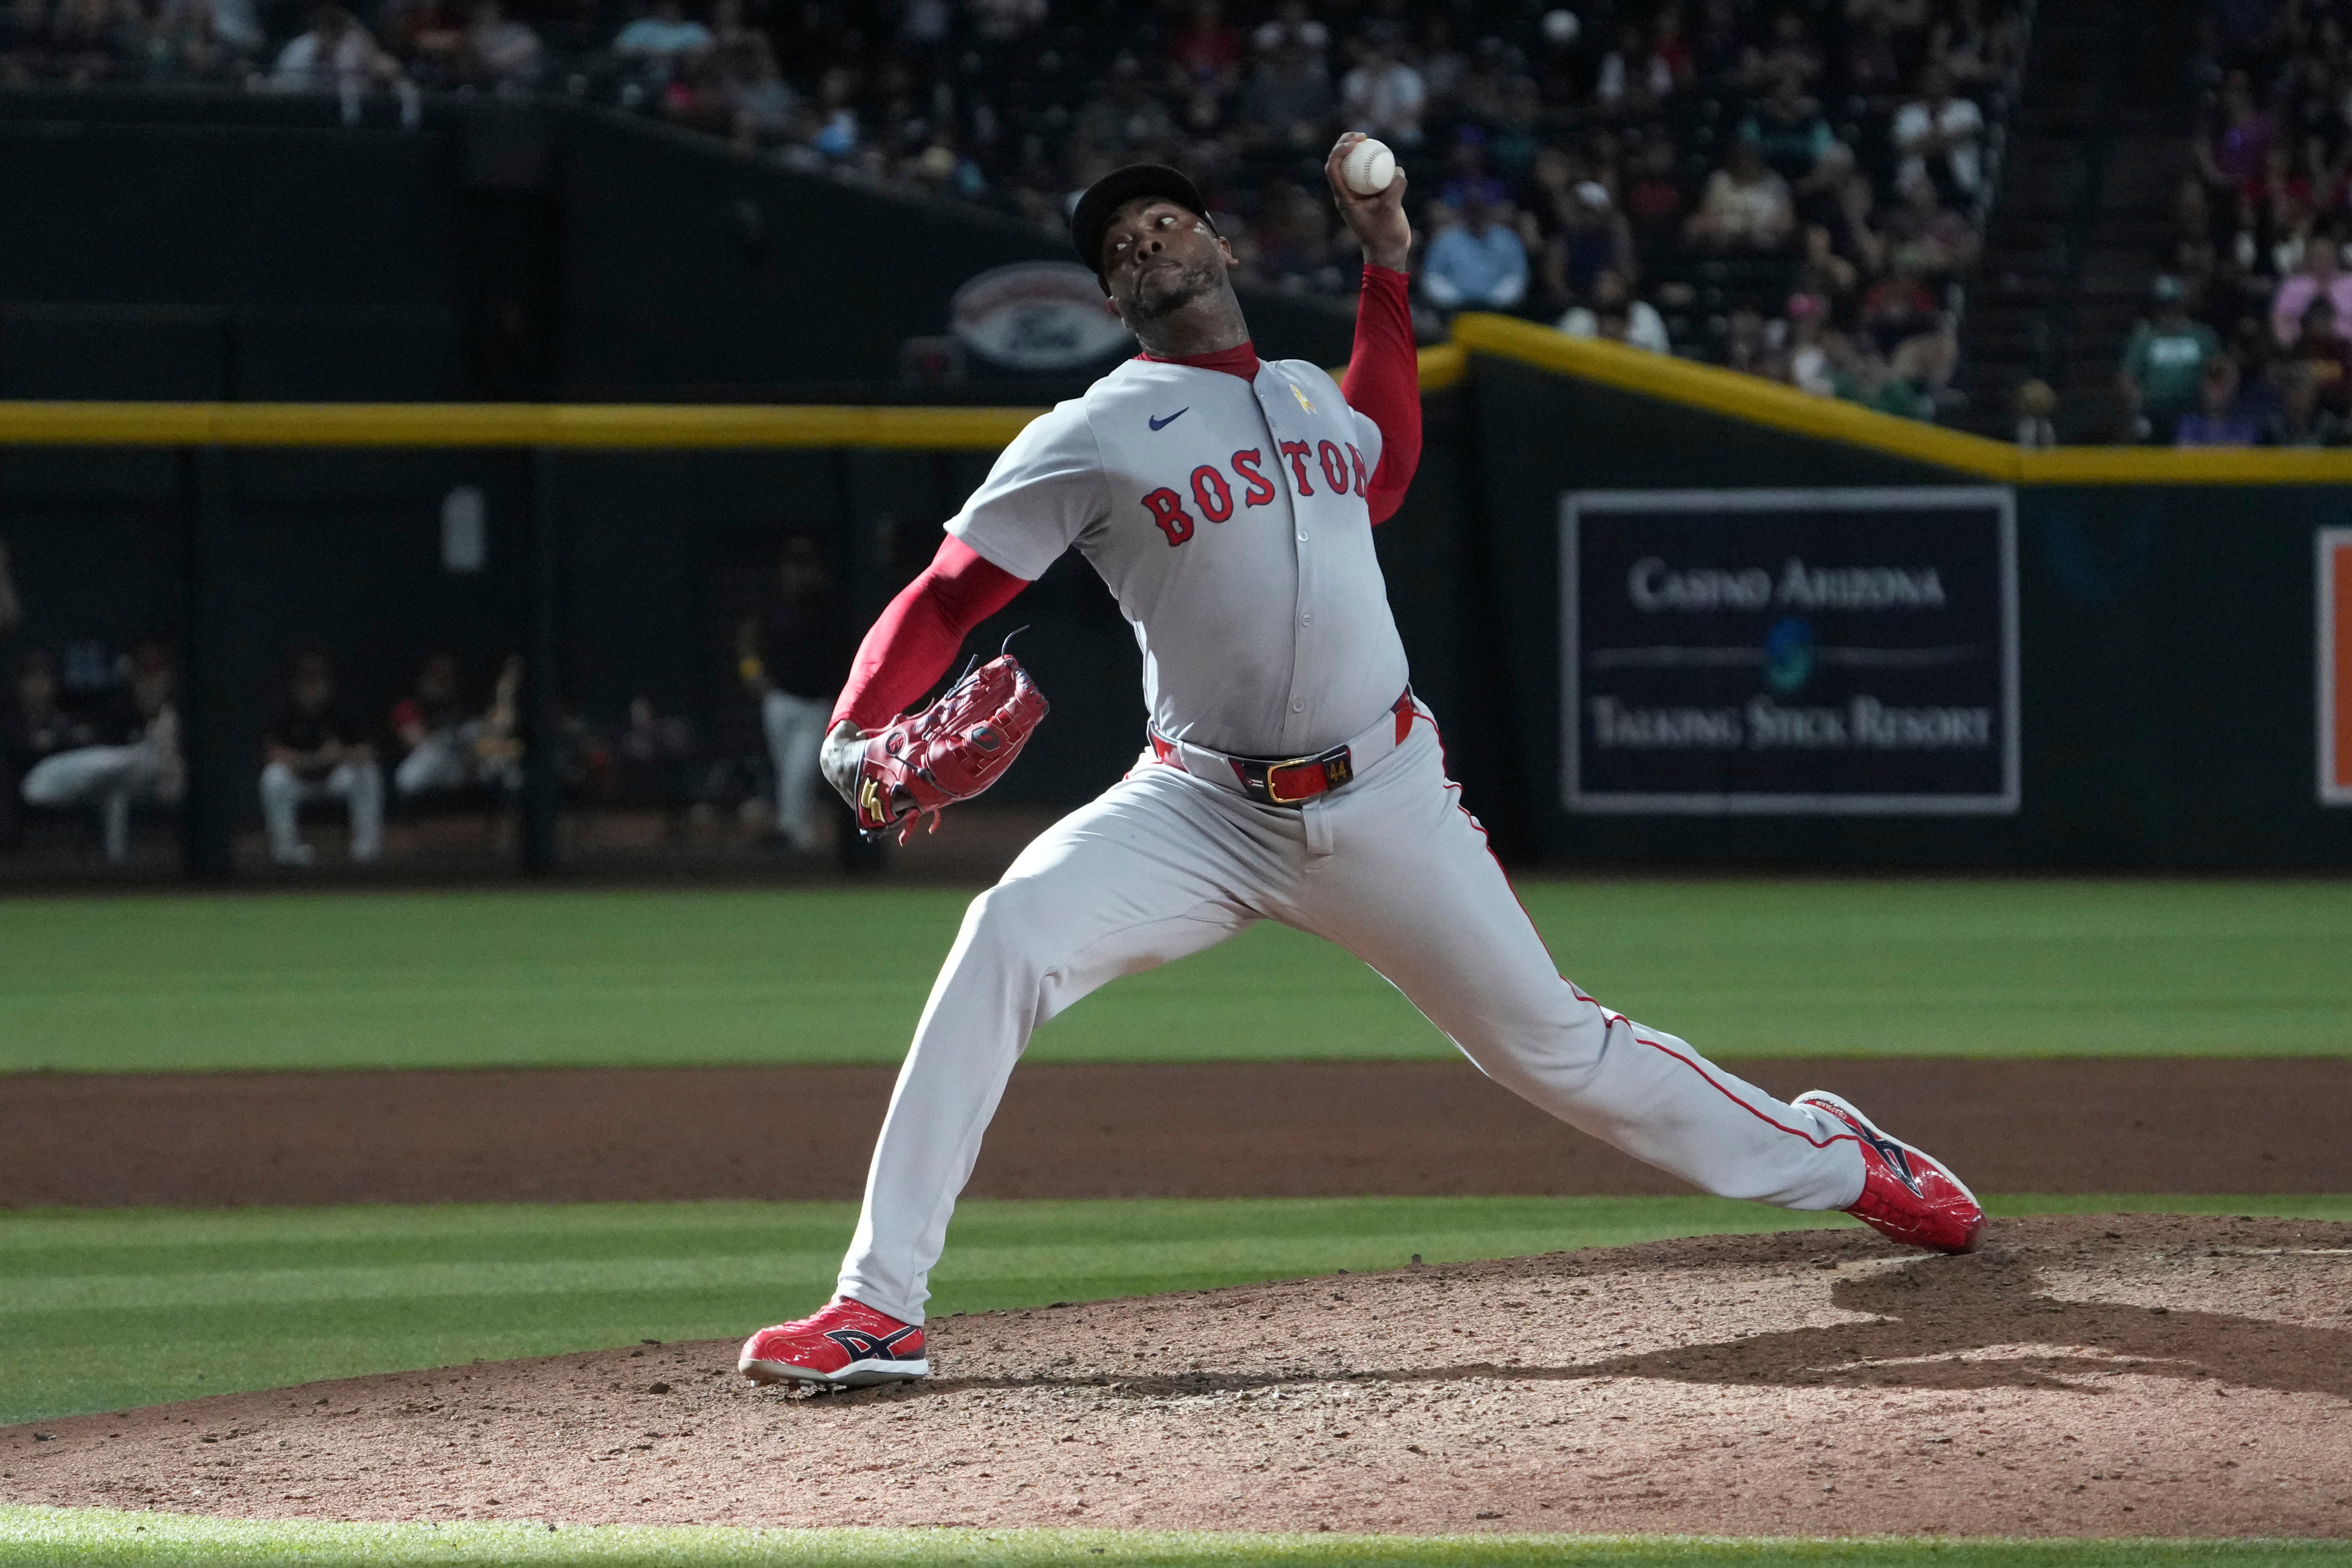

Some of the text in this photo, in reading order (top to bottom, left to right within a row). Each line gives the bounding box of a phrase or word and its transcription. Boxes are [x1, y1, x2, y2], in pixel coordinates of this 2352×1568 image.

[1141, 438, 1368, 547] BOSTON
[1330, 760, 1347, 781] 44
[1816, 1101, 1847, 1119] CHAPMAN
